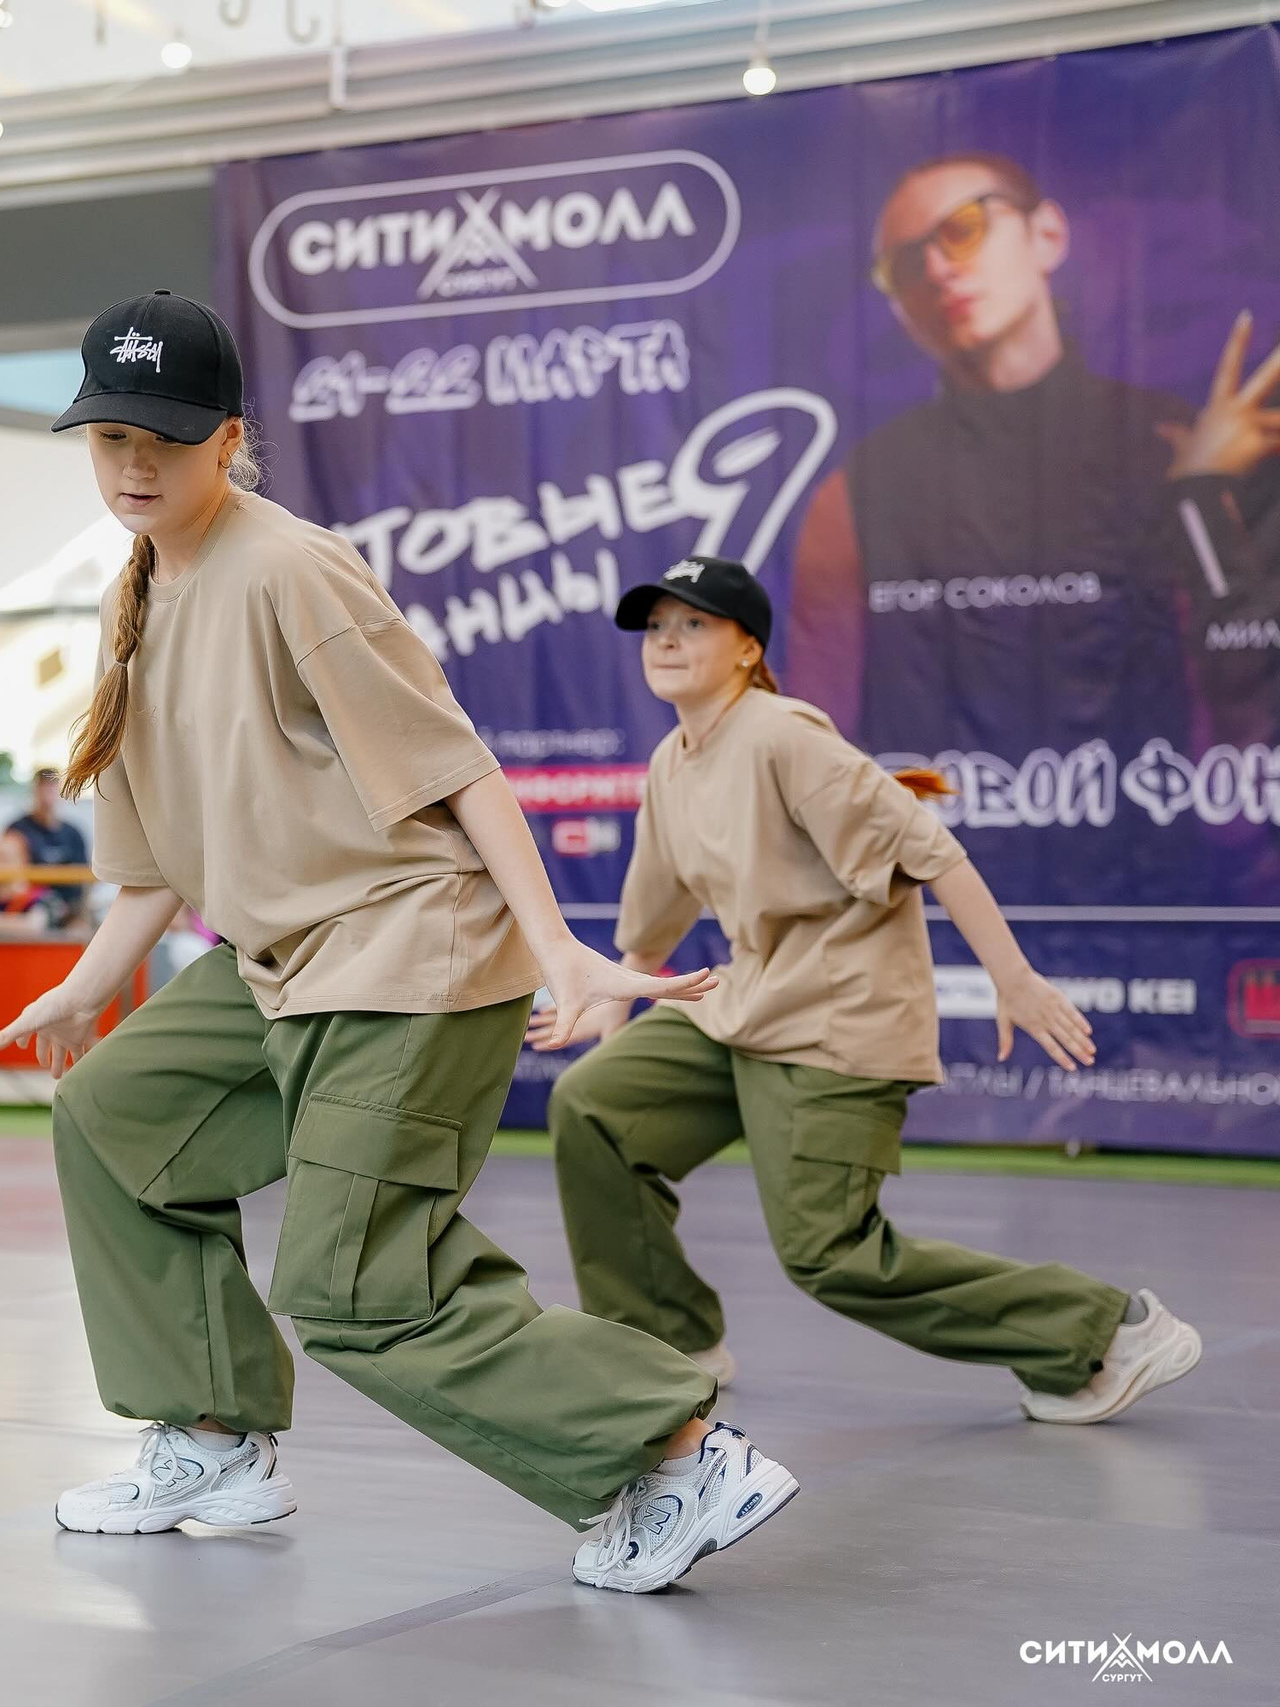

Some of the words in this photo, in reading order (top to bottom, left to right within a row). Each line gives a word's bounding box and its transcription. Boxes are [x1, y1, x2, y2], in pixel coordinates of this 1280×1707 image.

[288, 208, 452, 276] СИТИ
[501, 183, 696, 251] МОЛЛ
[328, 458, 675, 592] ТОВЫЕ
